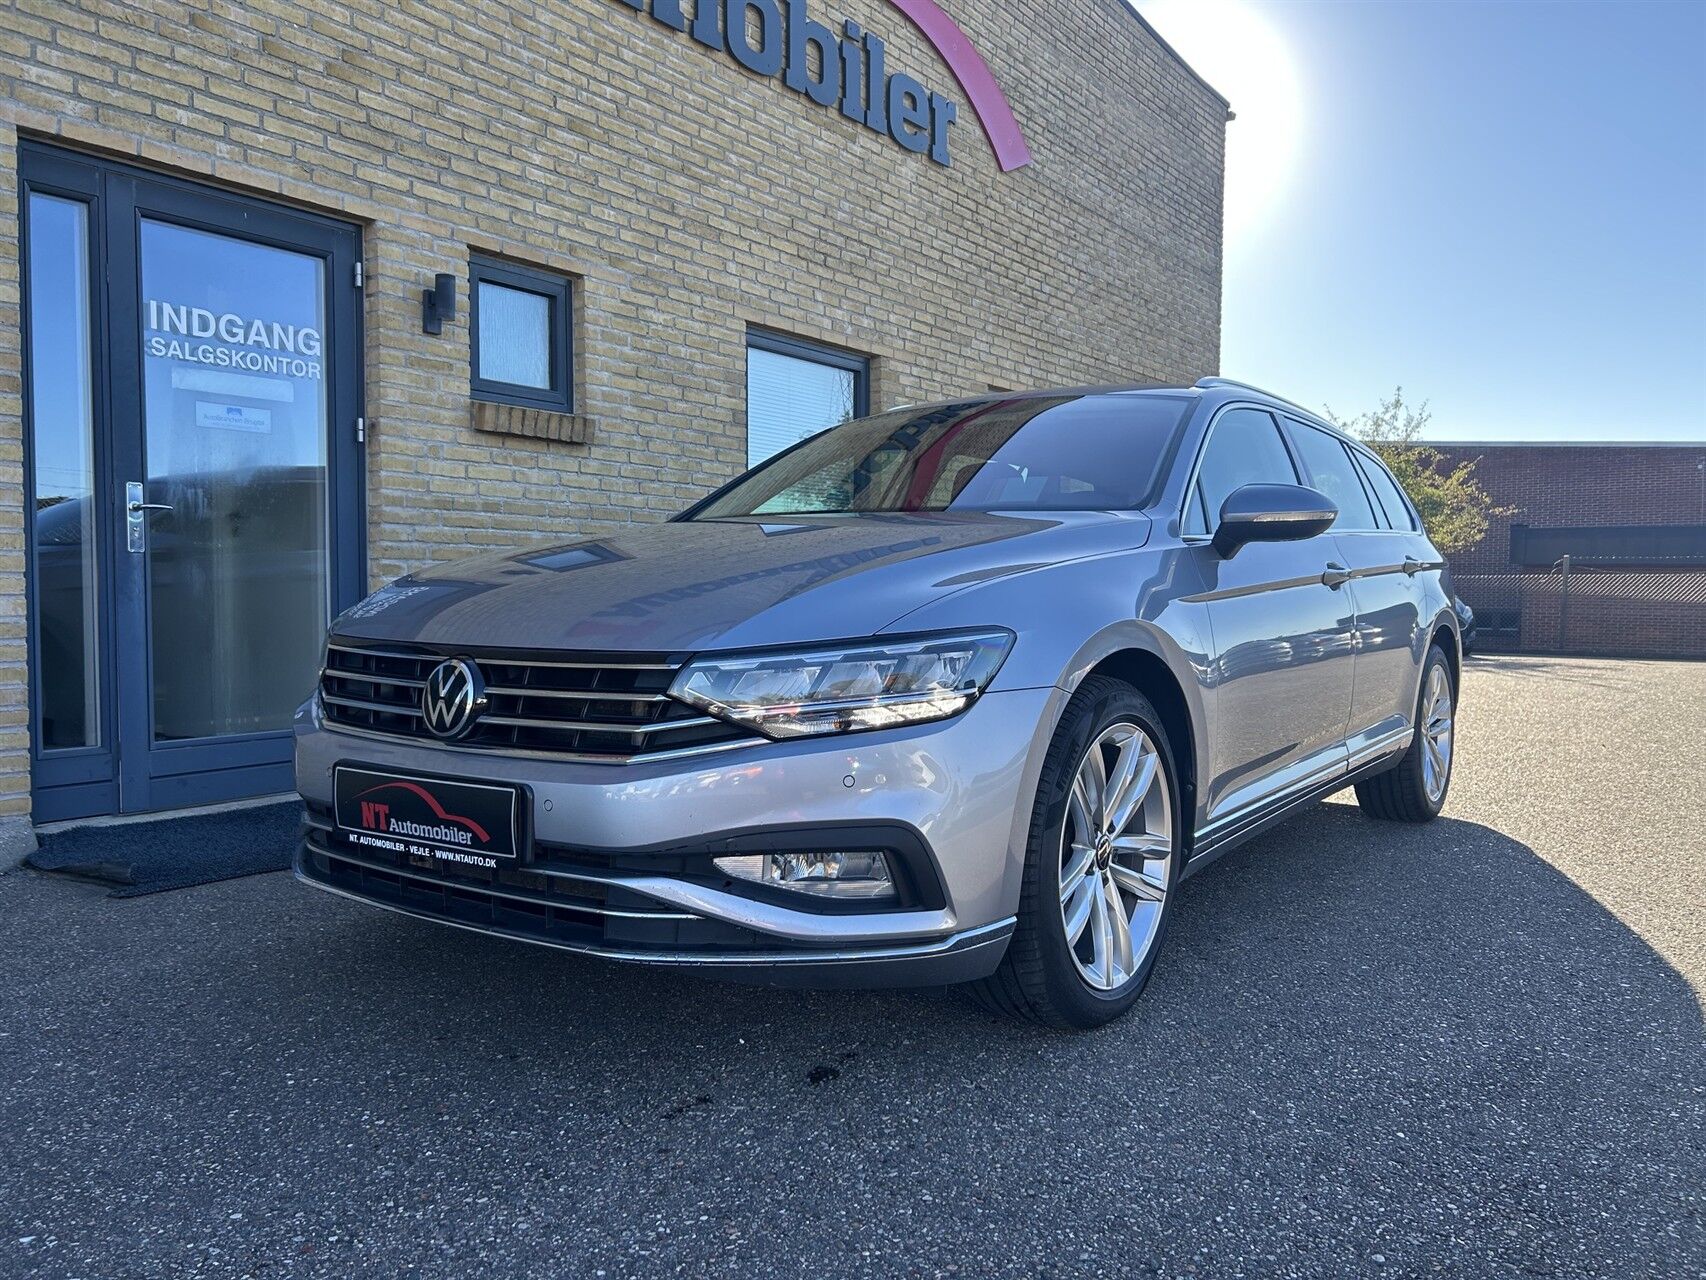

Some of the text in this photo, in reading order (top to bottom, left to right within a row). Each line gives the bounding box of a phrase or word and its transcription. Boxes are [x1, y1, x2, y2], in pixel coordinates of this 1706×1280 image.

[150, 300, 321, 357] INDGANG
[151, 337, 321, 379] SALGSKONTOR
[361, 801, 472, 845] NT Automobiler
[360, 836, 405, 852] AUTOMOBILER
[409, 845, 430, 857] VEJLE
[435, 850, 497, 868] WWW.NTAUTO.DK
